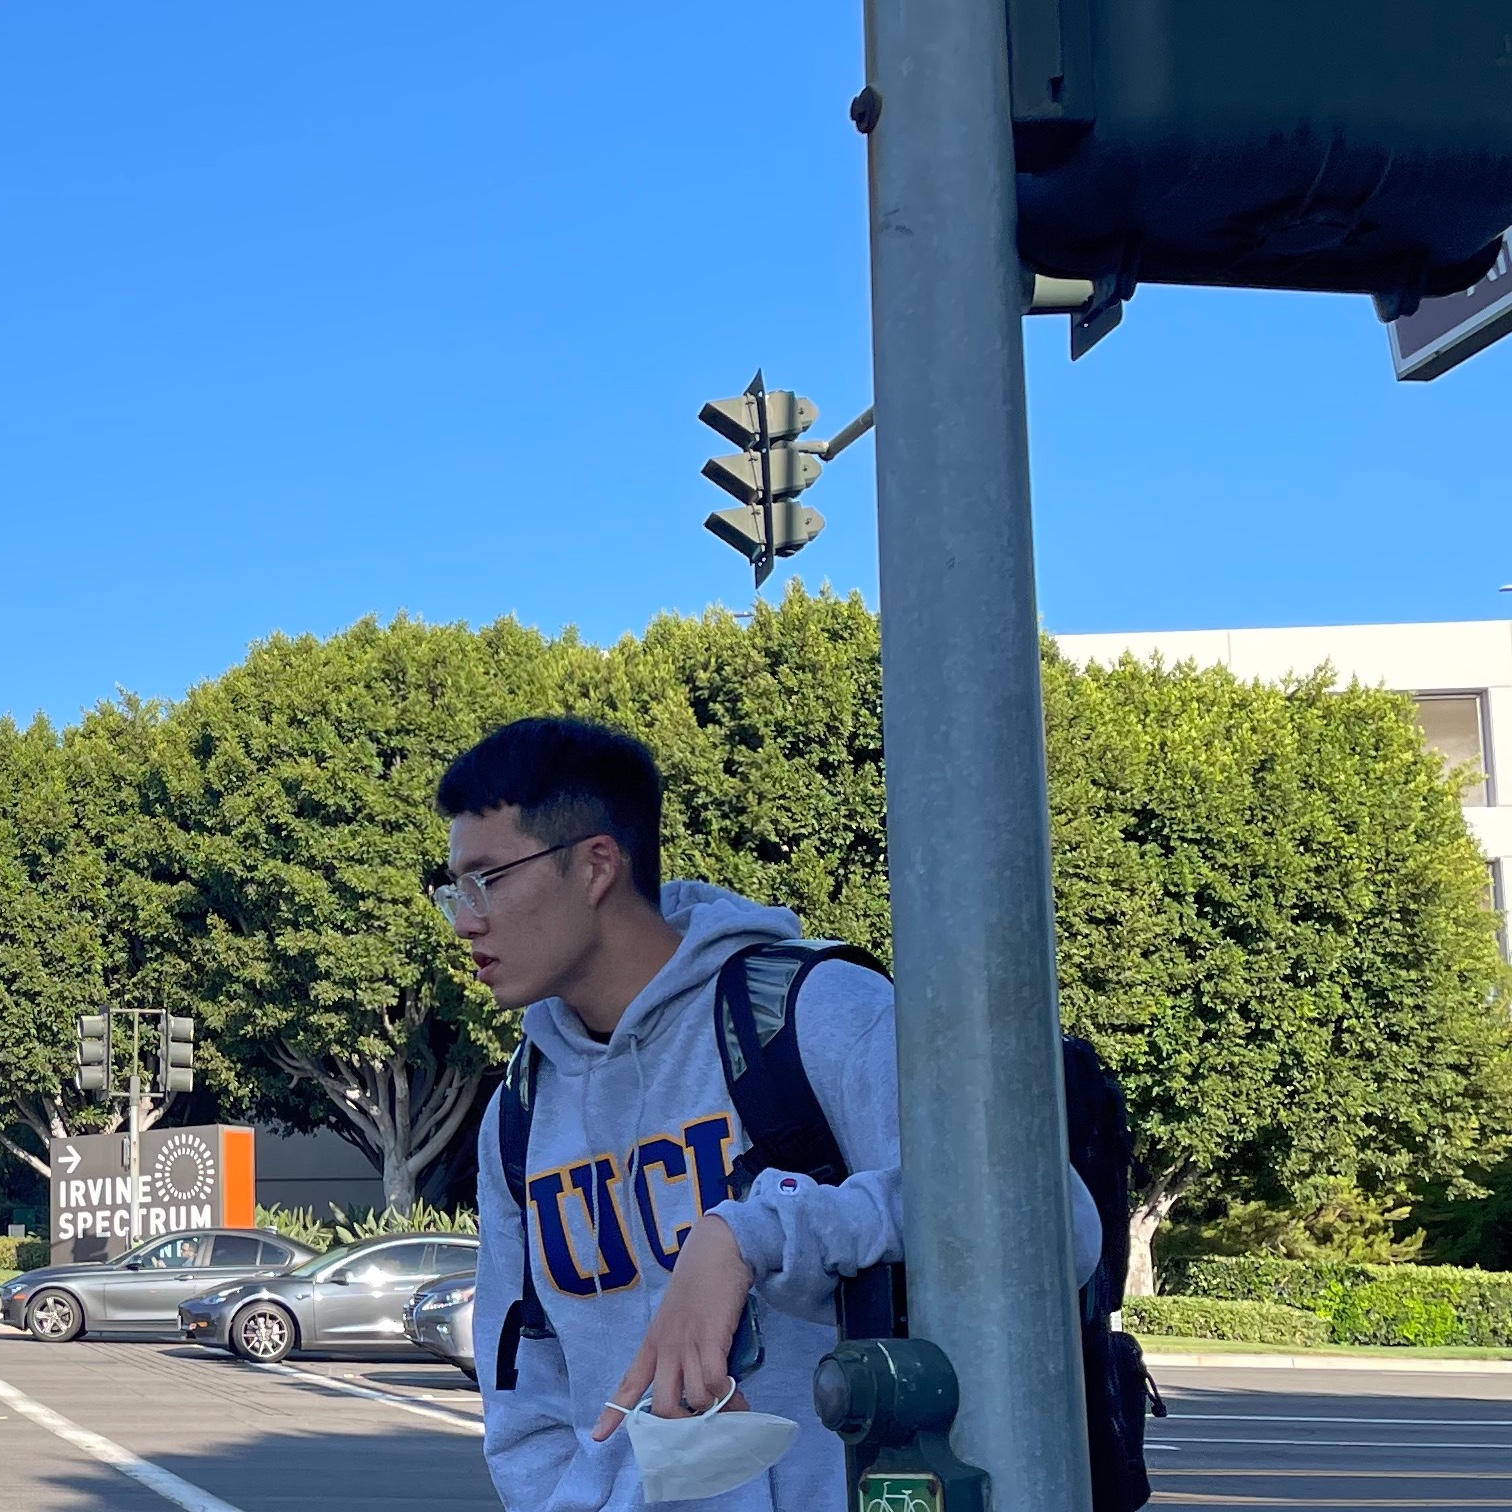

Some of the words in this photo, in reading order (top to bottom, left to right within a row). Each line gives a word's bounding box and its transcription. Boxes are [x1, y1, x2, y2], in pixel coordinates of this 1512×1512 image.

[59, 1175, 152, 1208] IRVINE
[528, 1111, 734, 1298] UCI
[58, 1204, 211, 1240] SPECTRUM
